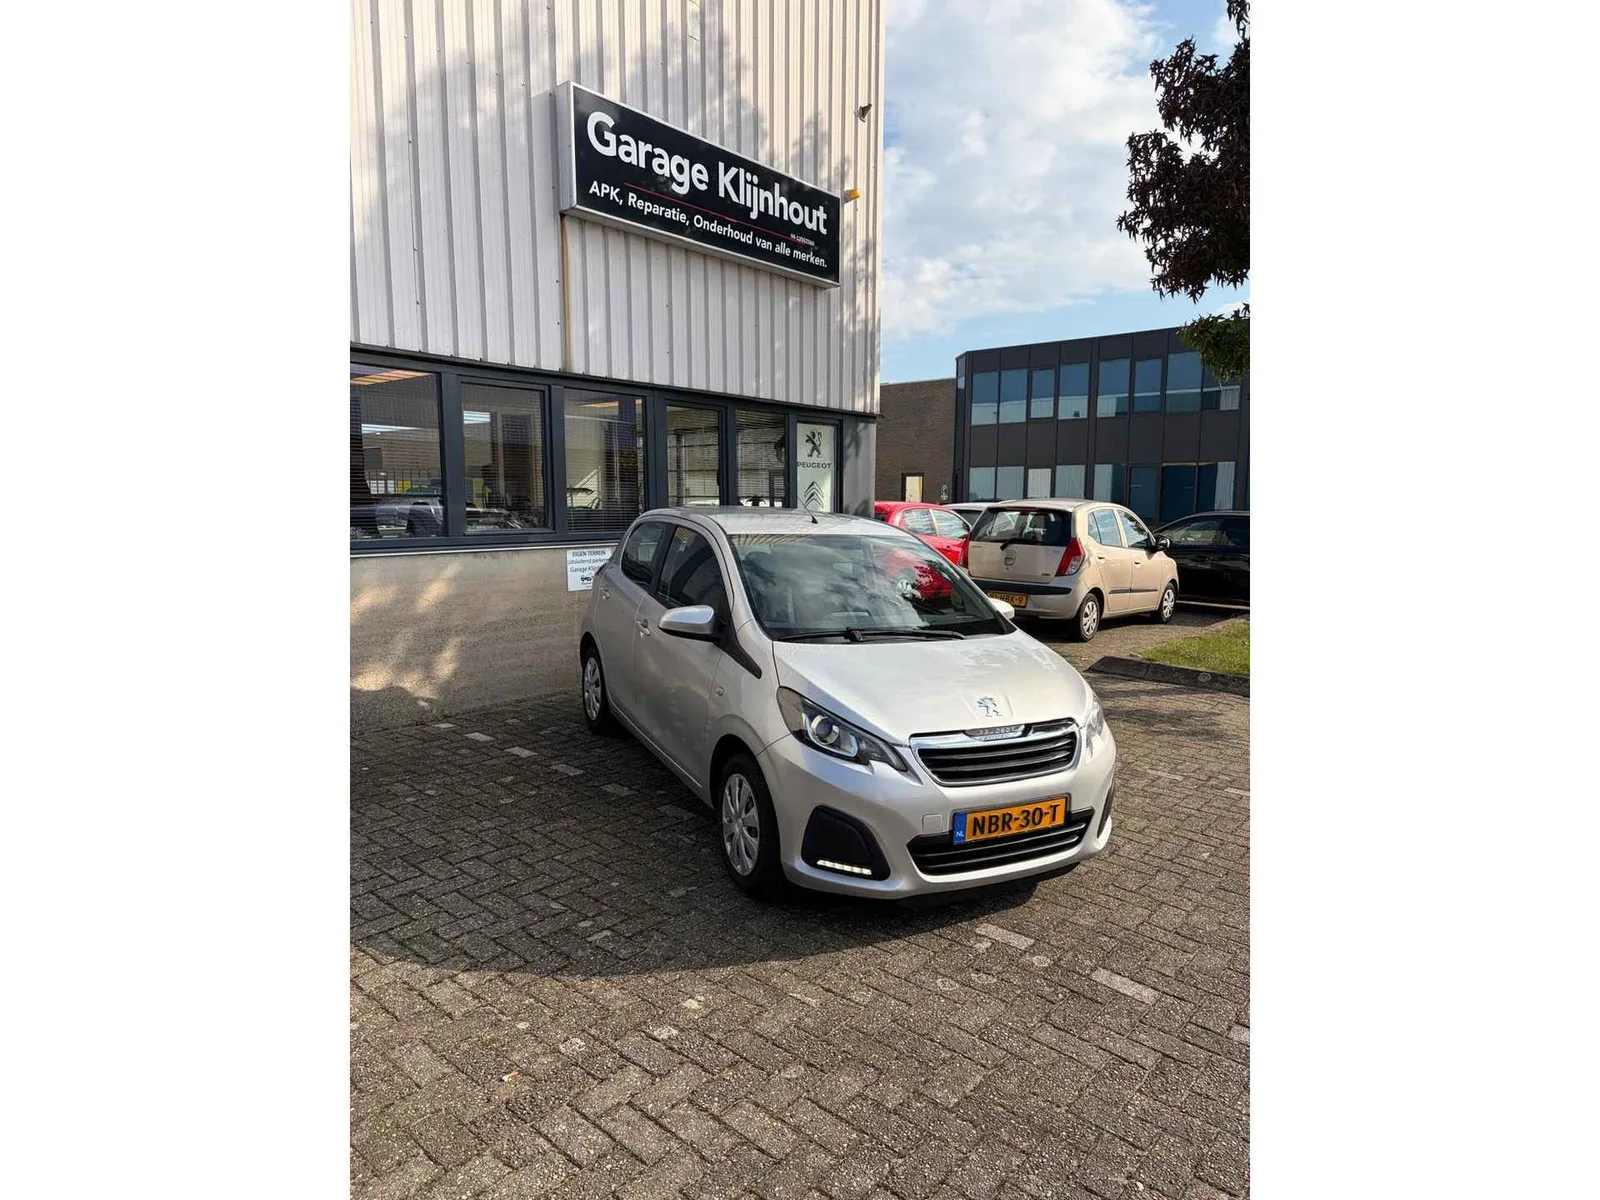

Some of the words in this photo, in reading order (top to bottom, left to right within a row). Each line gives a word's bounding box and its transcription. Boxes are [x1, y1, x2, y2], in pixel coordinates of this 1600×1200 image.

[587, 111, 709, 195] Garage
[718, 161, 828, 236] Klijnhout
[589, 180, 623, 206] APK,
[628, 193, 690, 227] Reparatie,
[693, 214, 753, 245] Onderhoud
[755, 236, 773, 251] van
[775, 241, 791, 257] alle
[792, 249, 828, 268] merken.
[796, 461, 832, 469] PEUGEOT
[972, 804, 1061, 837] NBR-30-T
